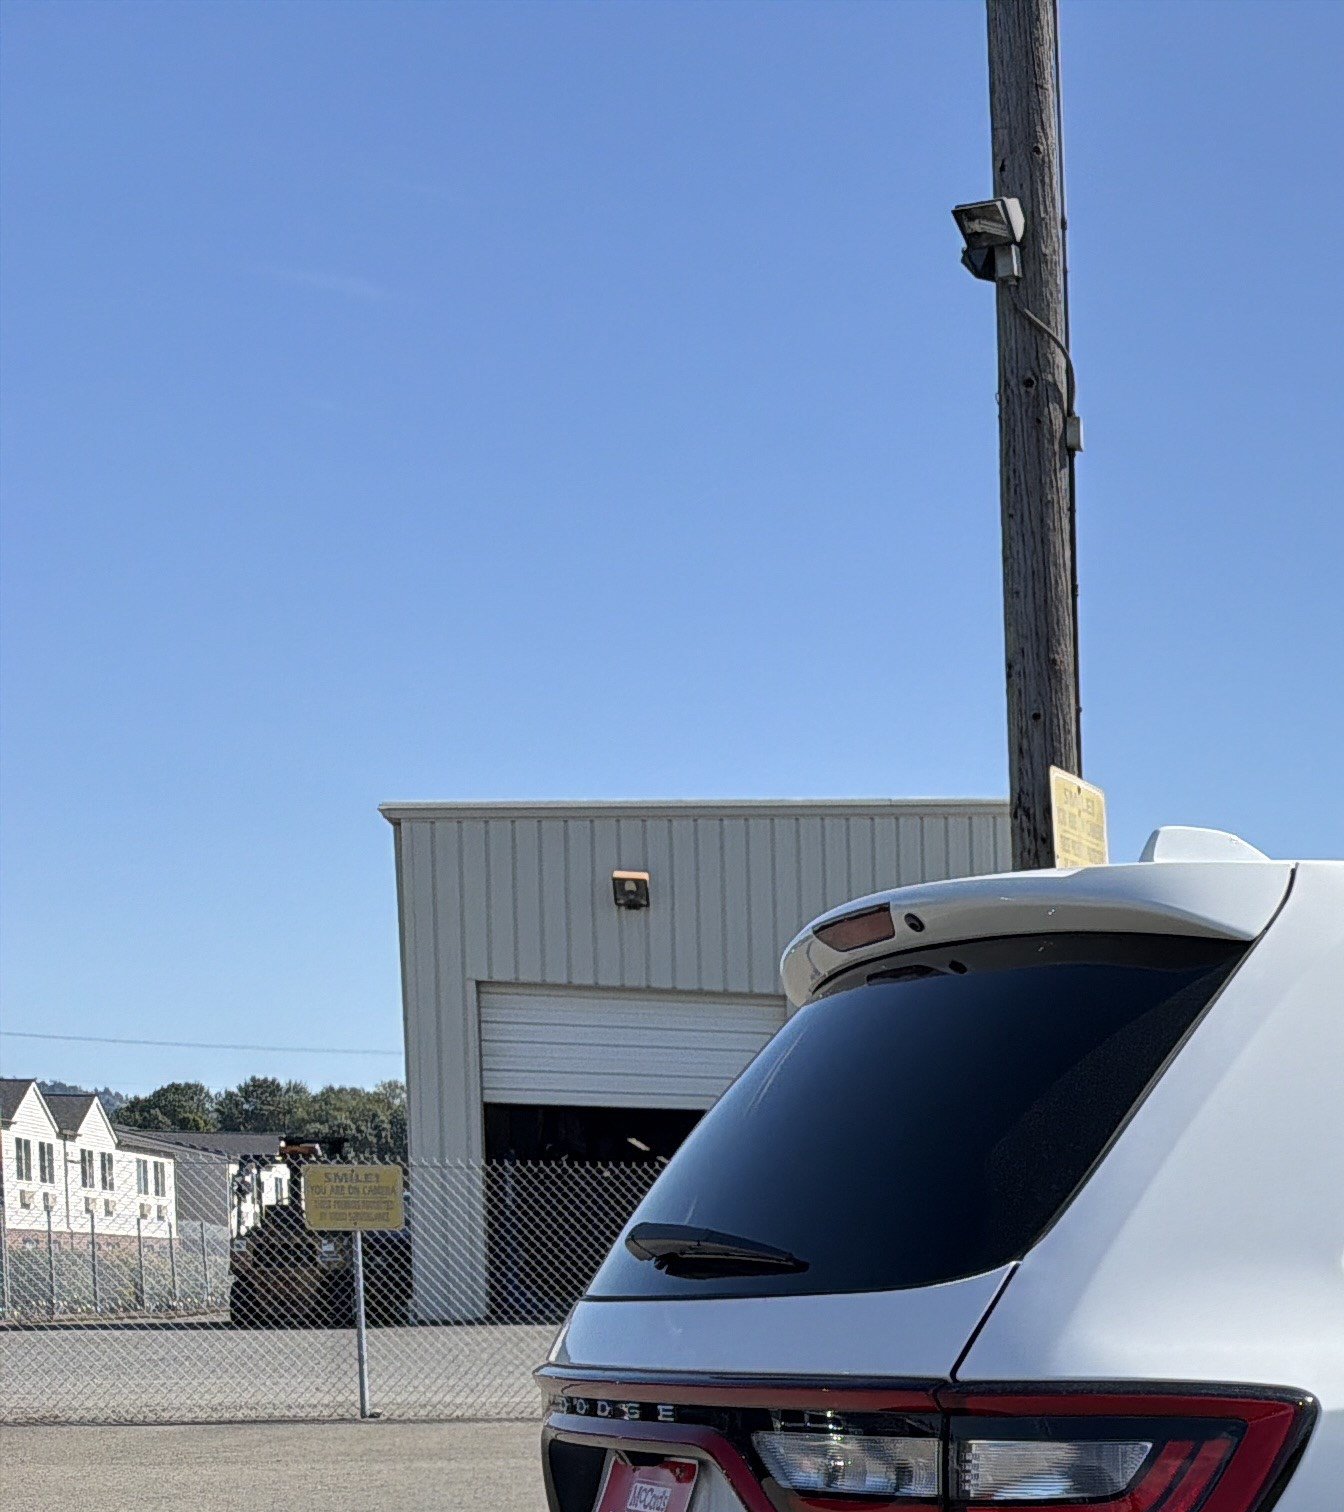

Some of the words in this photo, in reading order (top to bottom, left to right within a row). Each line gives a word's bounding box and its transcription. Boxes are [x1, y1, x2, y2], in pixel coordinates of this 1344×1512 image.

[324, 1172, 380, 1183] SMILE!
[310, 1185, 326, 1195] YOU
[558, 1397, 675, 1422] DODGE
